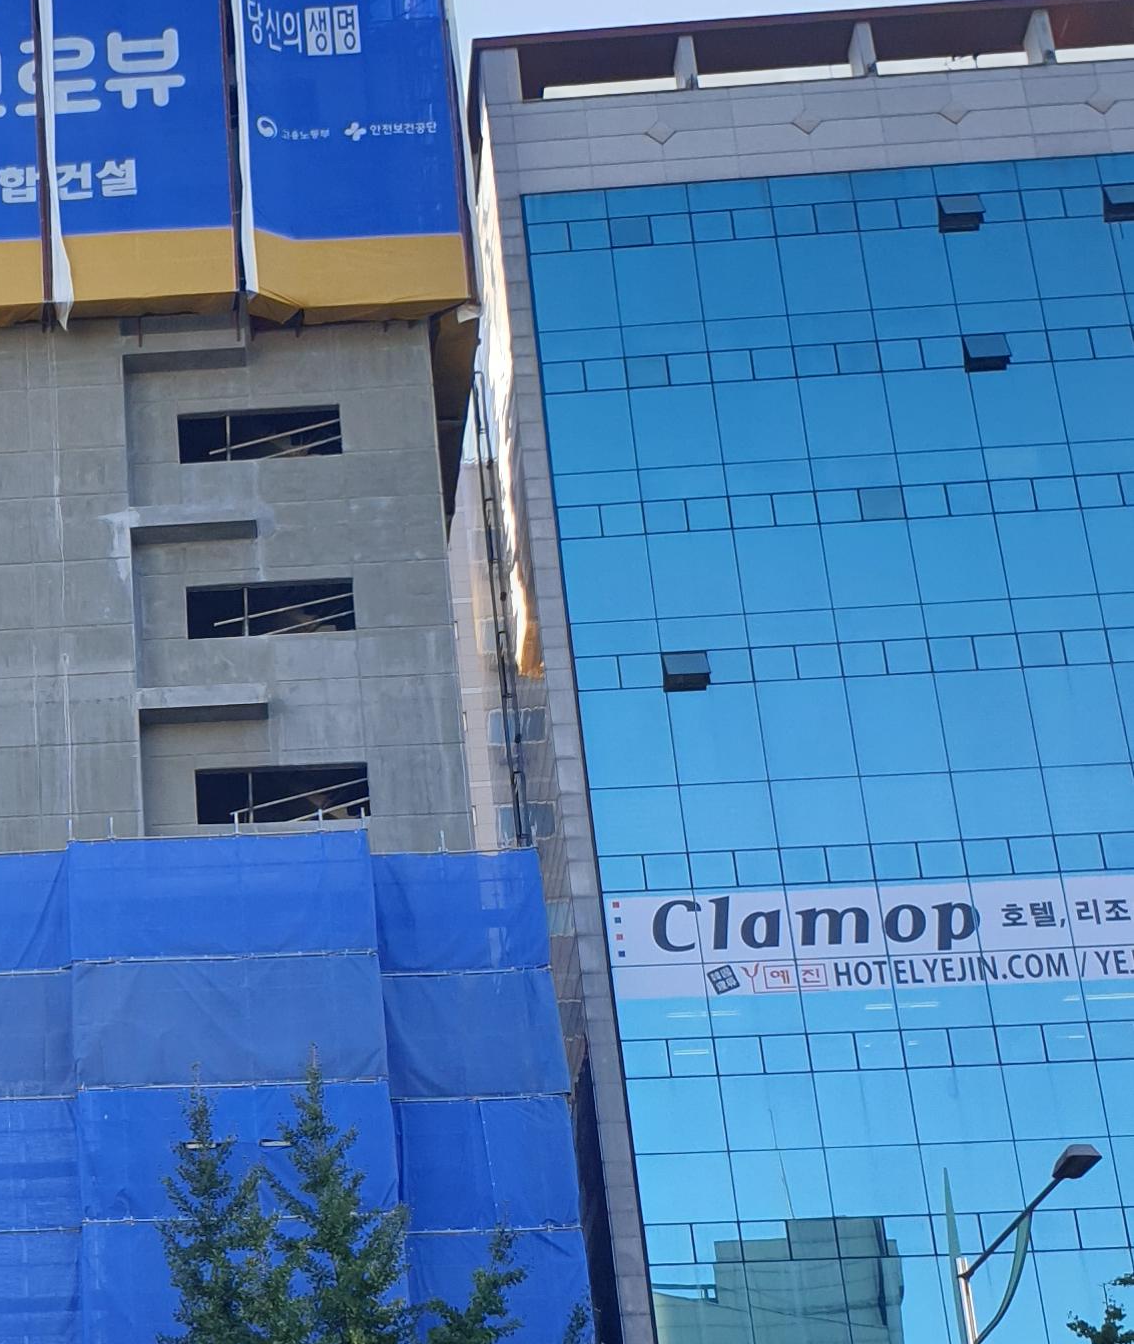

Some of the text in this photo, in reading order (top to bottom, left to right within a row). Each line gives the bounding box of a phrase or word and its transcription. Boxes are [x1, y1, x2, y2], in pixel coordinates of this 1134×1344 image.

[305, 7, 361, 54] 생명
[651, 895, 982, 953] Clamop
[1000, 900, 1066, 928] 호텔,
[833, 951, 1070, 987] HOTELYEJIN.COM
